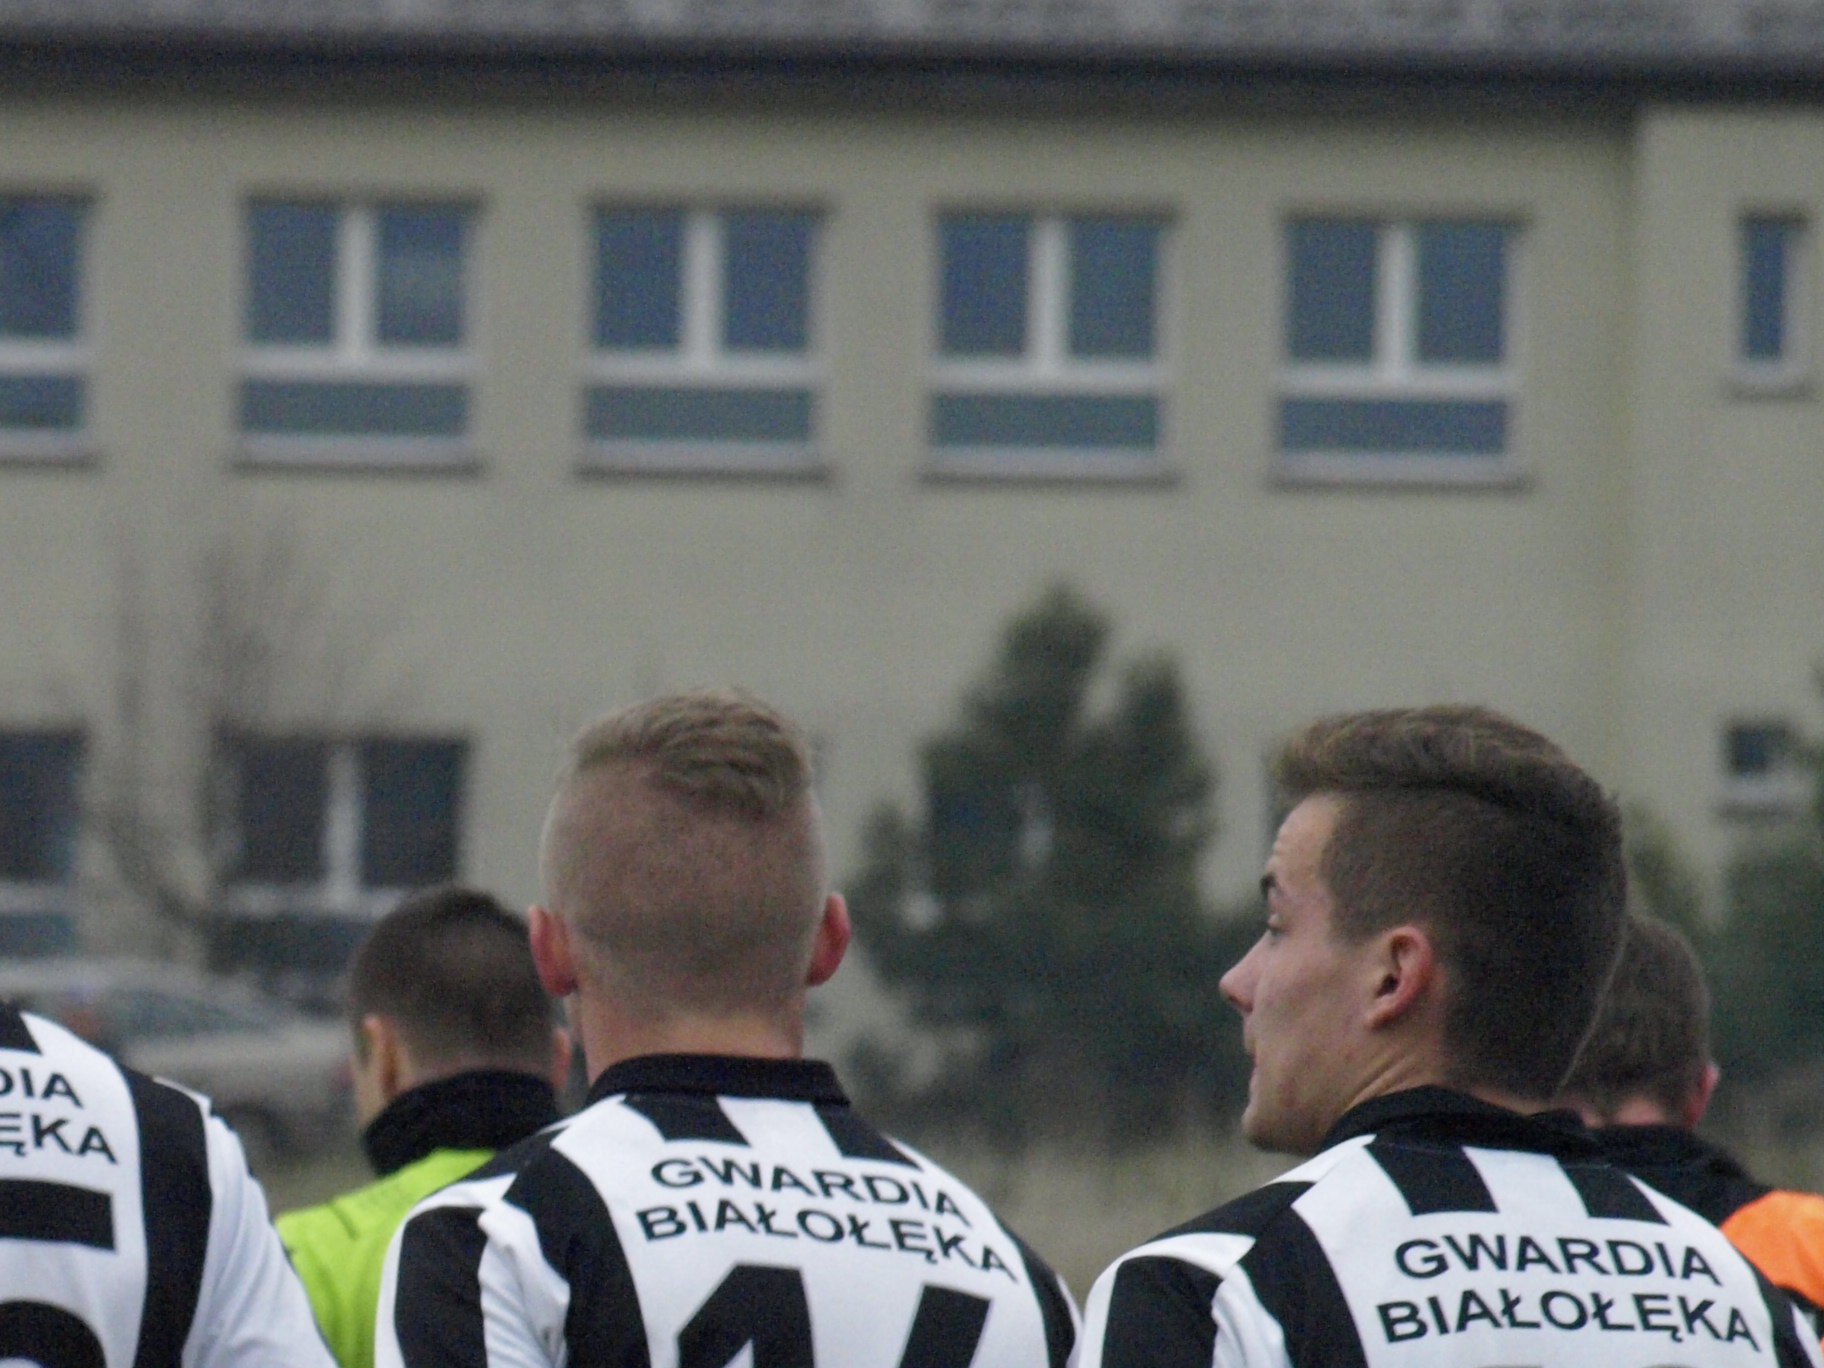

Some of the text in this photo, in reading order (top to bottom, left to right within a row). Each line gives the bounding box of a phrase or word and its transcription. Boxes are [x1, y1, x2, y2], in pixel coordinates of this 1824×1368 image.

[650, 1156, 975, 1227] GWARDIA
[635, 1199, 1019, 1285] BIAŁOŁĘKA
[1393, 1233, 1723, 1288] GWARDIA
[1375, 1288, 1762, 1353] BIAŁOŁĘKA
